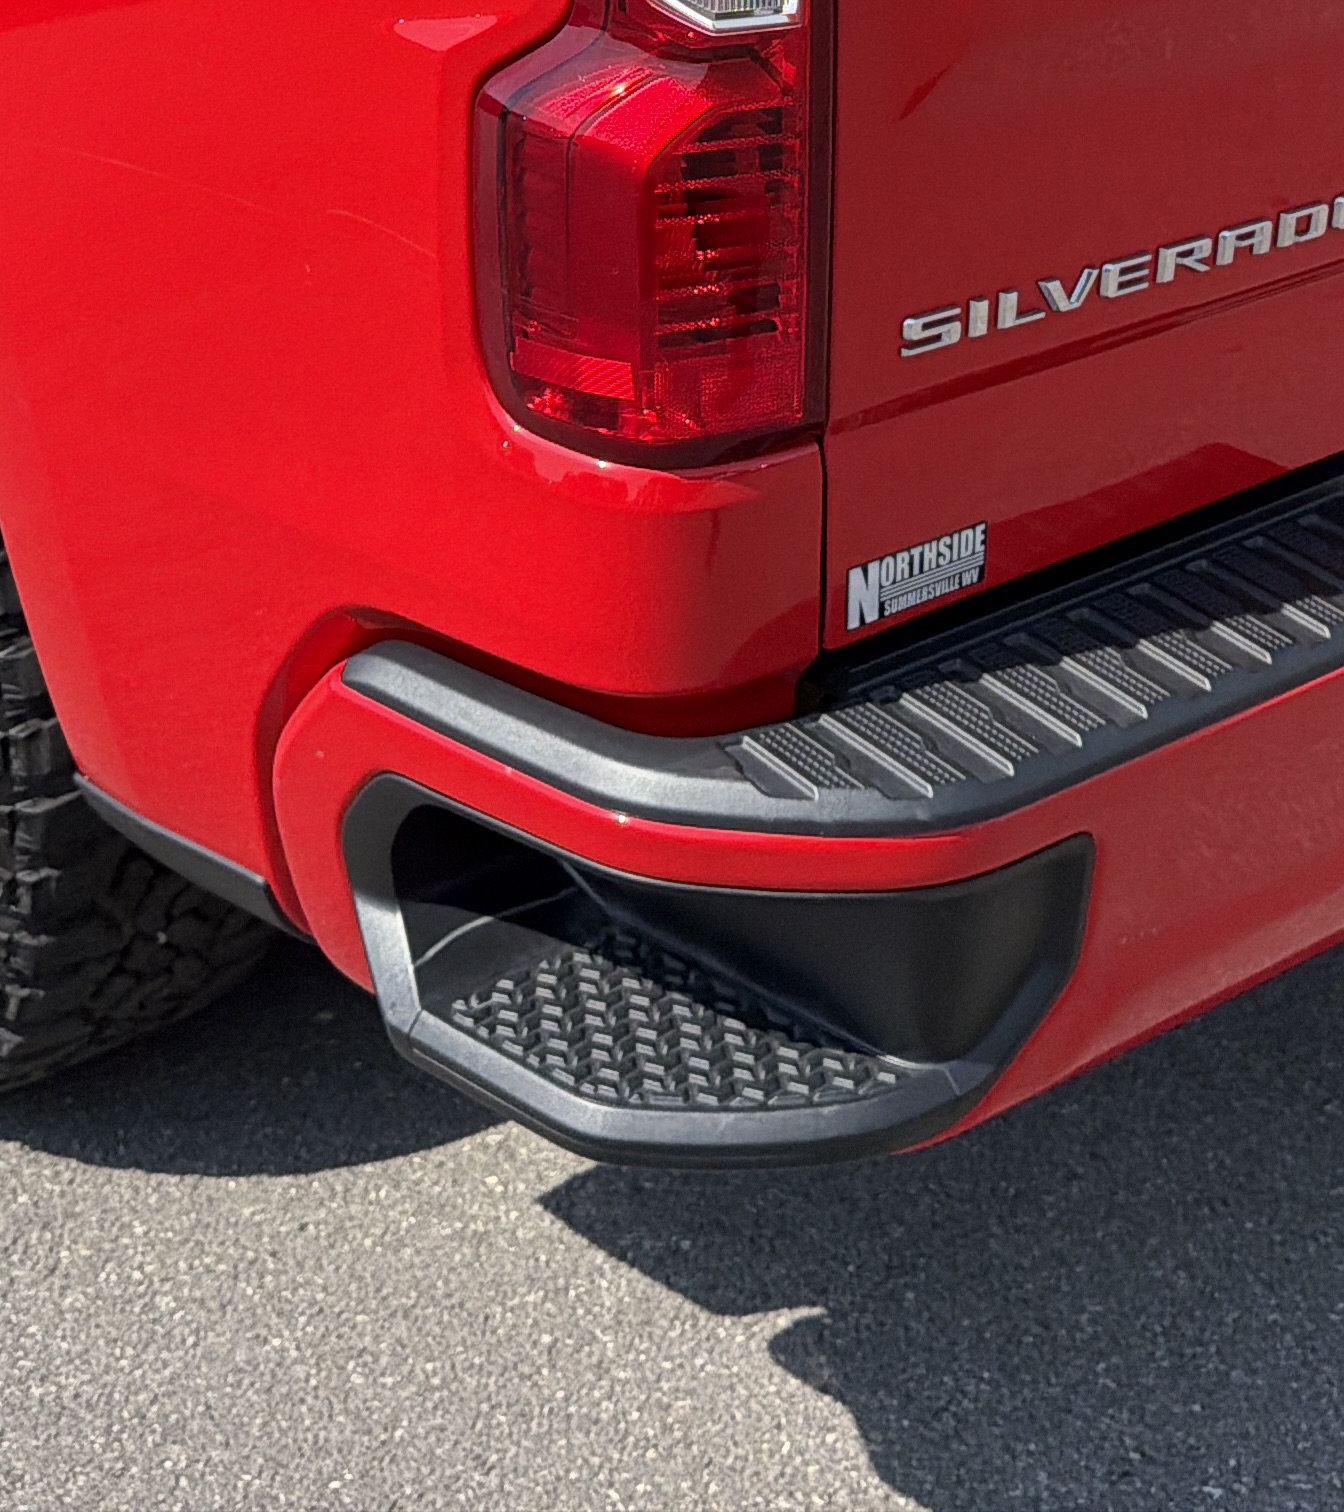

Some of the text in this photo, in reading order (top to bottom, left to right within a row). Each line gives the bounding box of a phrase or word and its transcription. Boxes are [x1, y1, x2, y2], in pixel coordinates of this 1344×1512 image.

[847, 522, 987, 631] NORTHSIDE
[884, 566, 981, 617] SUMMERSVILLE WV
